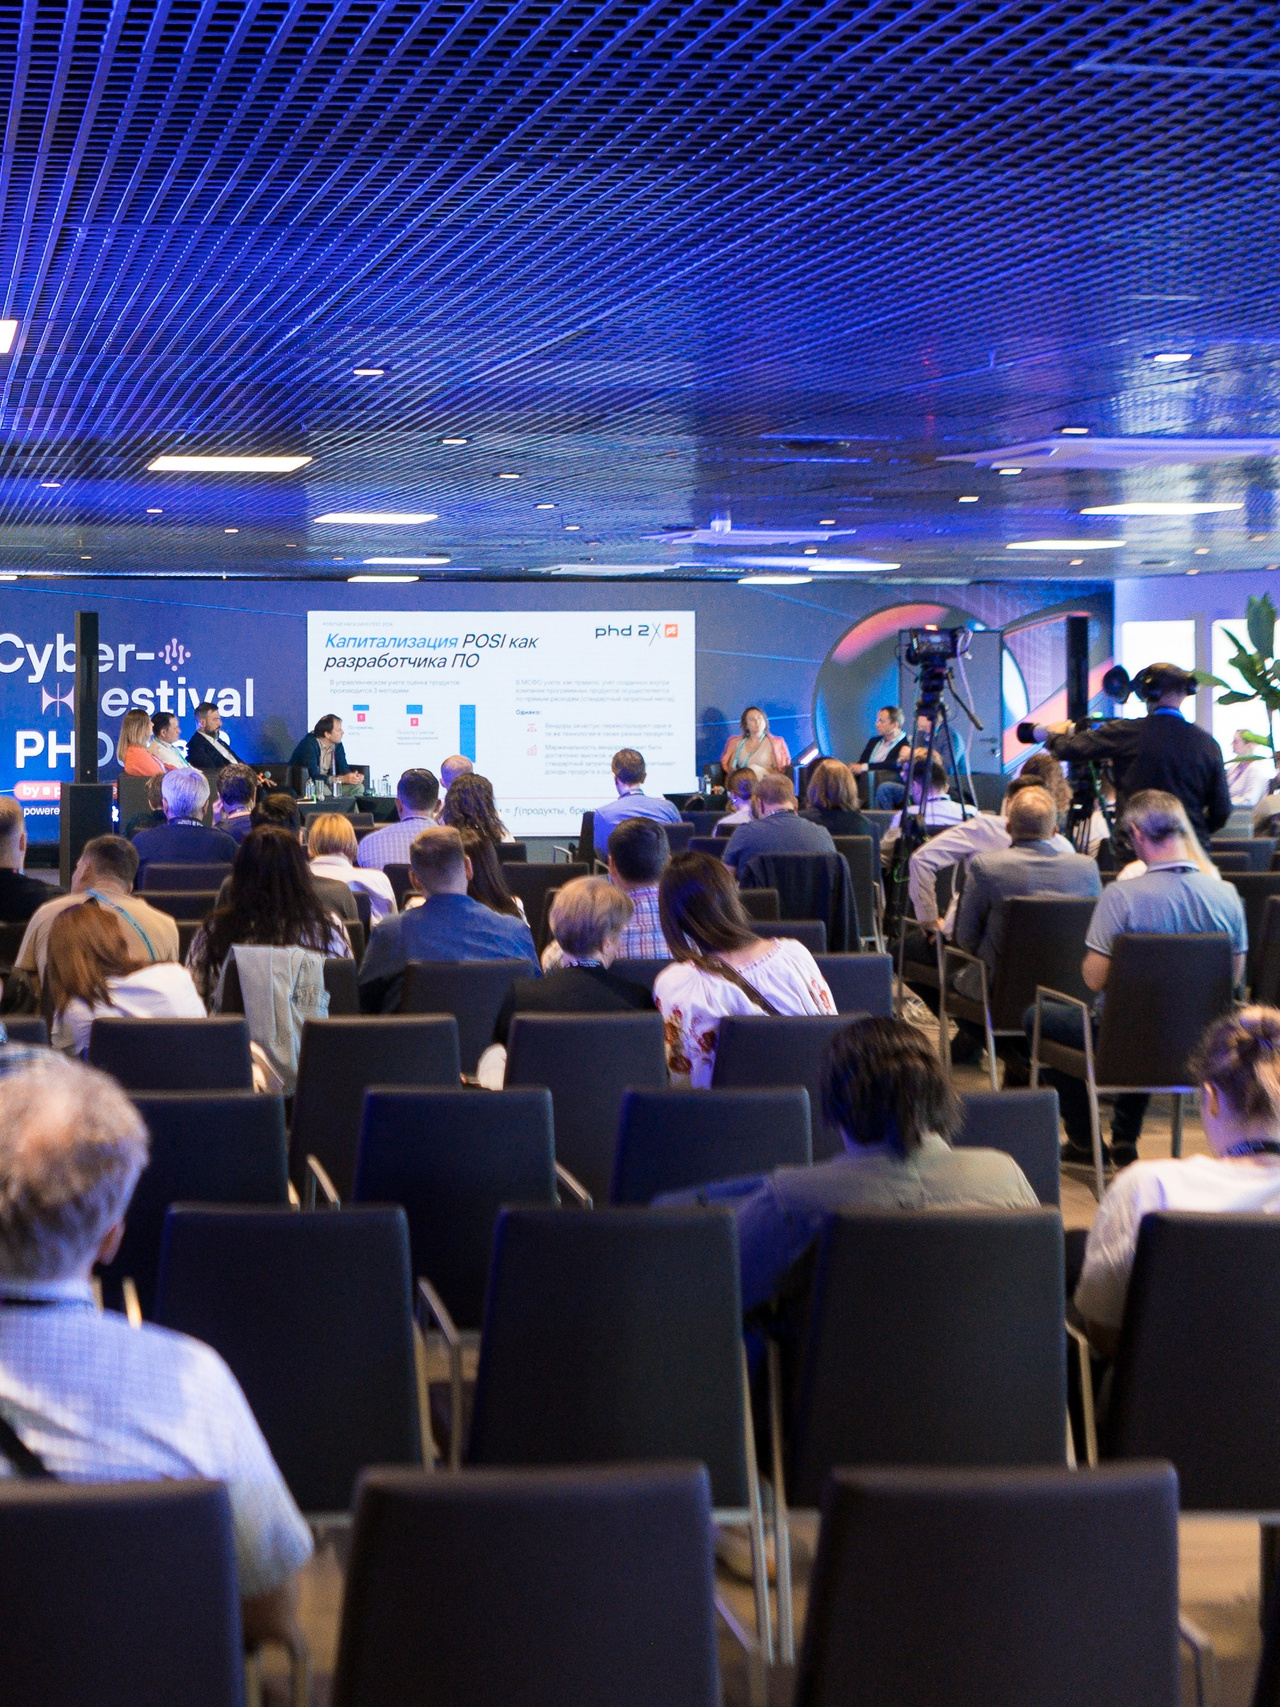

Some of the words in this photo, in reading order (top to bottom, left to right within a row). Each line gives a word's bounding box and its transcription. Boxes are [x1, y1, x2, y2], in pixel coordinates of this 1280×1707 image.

[595, 624, 632, 639] phd
[324, 633, 459, 651] Капитализация
[462, 633, 507, 649] POSI
[508, 636, 539, 649] как
[323, 652, 448, 672] разработчика
[451, 653, 480, 668] ПО
[22, 784, 40, 798] by
[23, 806, 61, 817] powere
